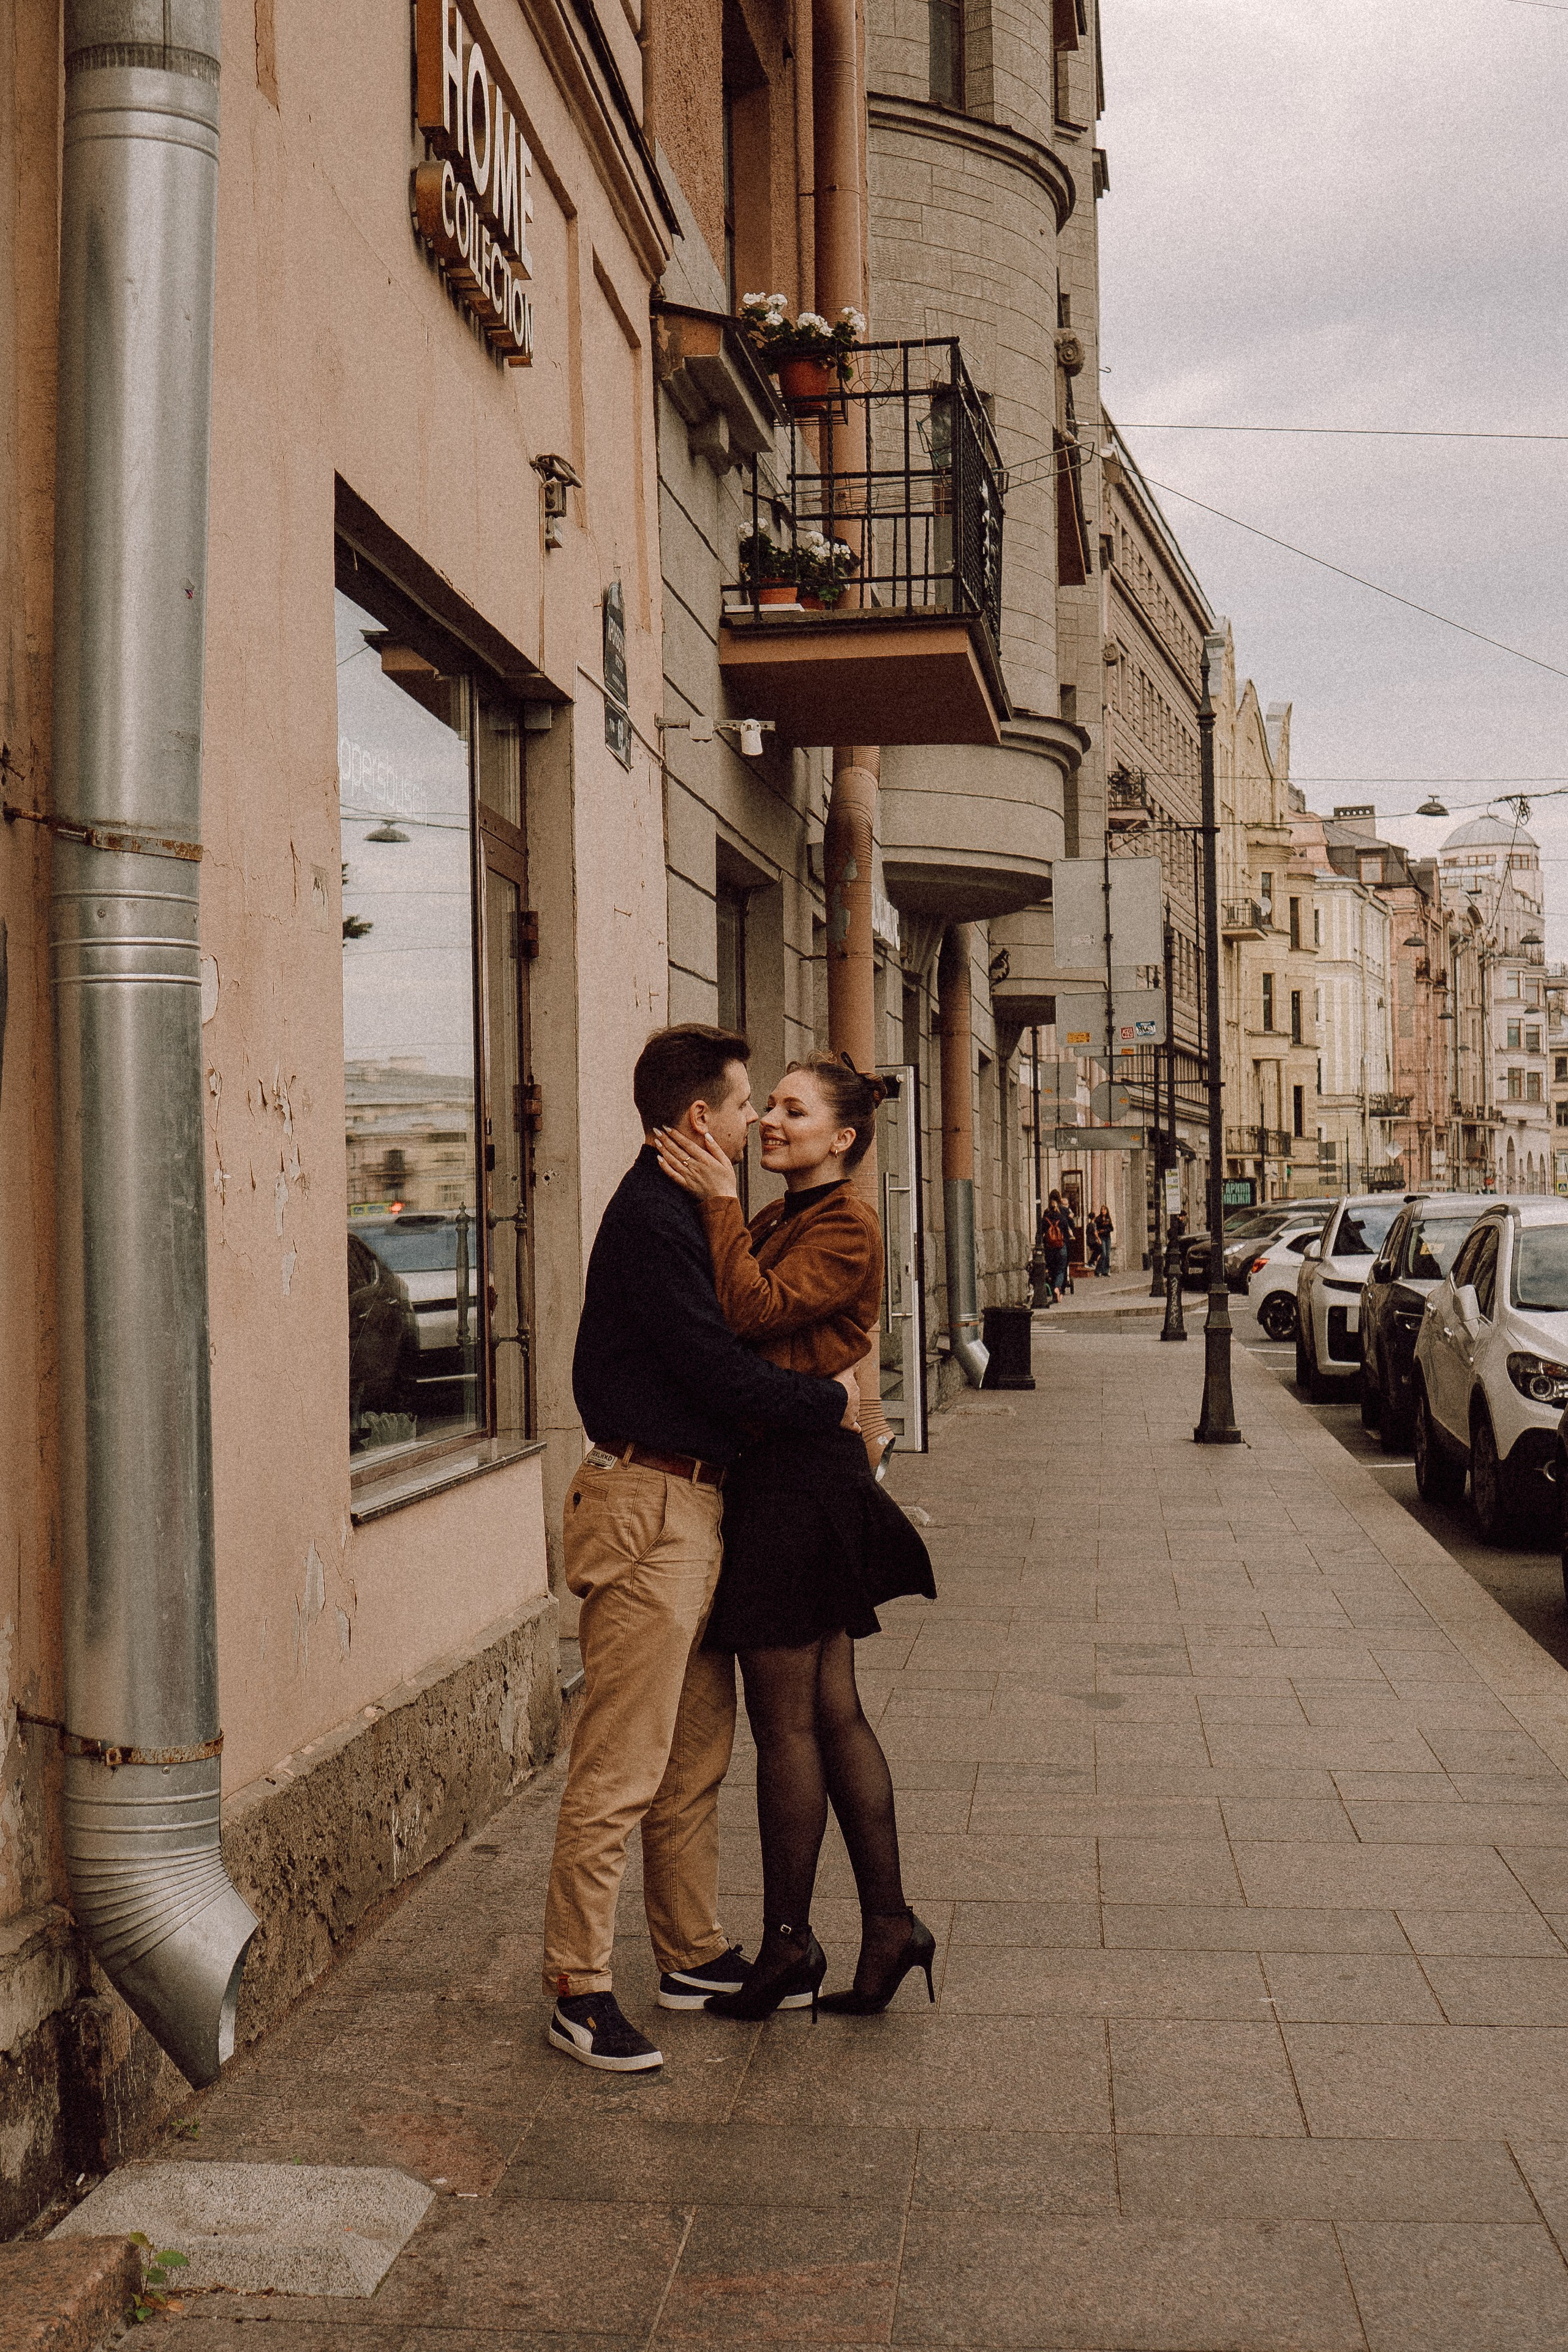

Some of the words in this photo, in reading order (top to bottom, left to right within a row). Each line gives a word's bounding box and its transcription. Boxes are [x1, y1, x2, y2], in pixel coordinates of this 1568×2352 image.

[442, 0, 533, 280] HOME
[442, 160, 533, 357] COLLECTION
[1226, 1182, 1250, 1194] АРХИП
